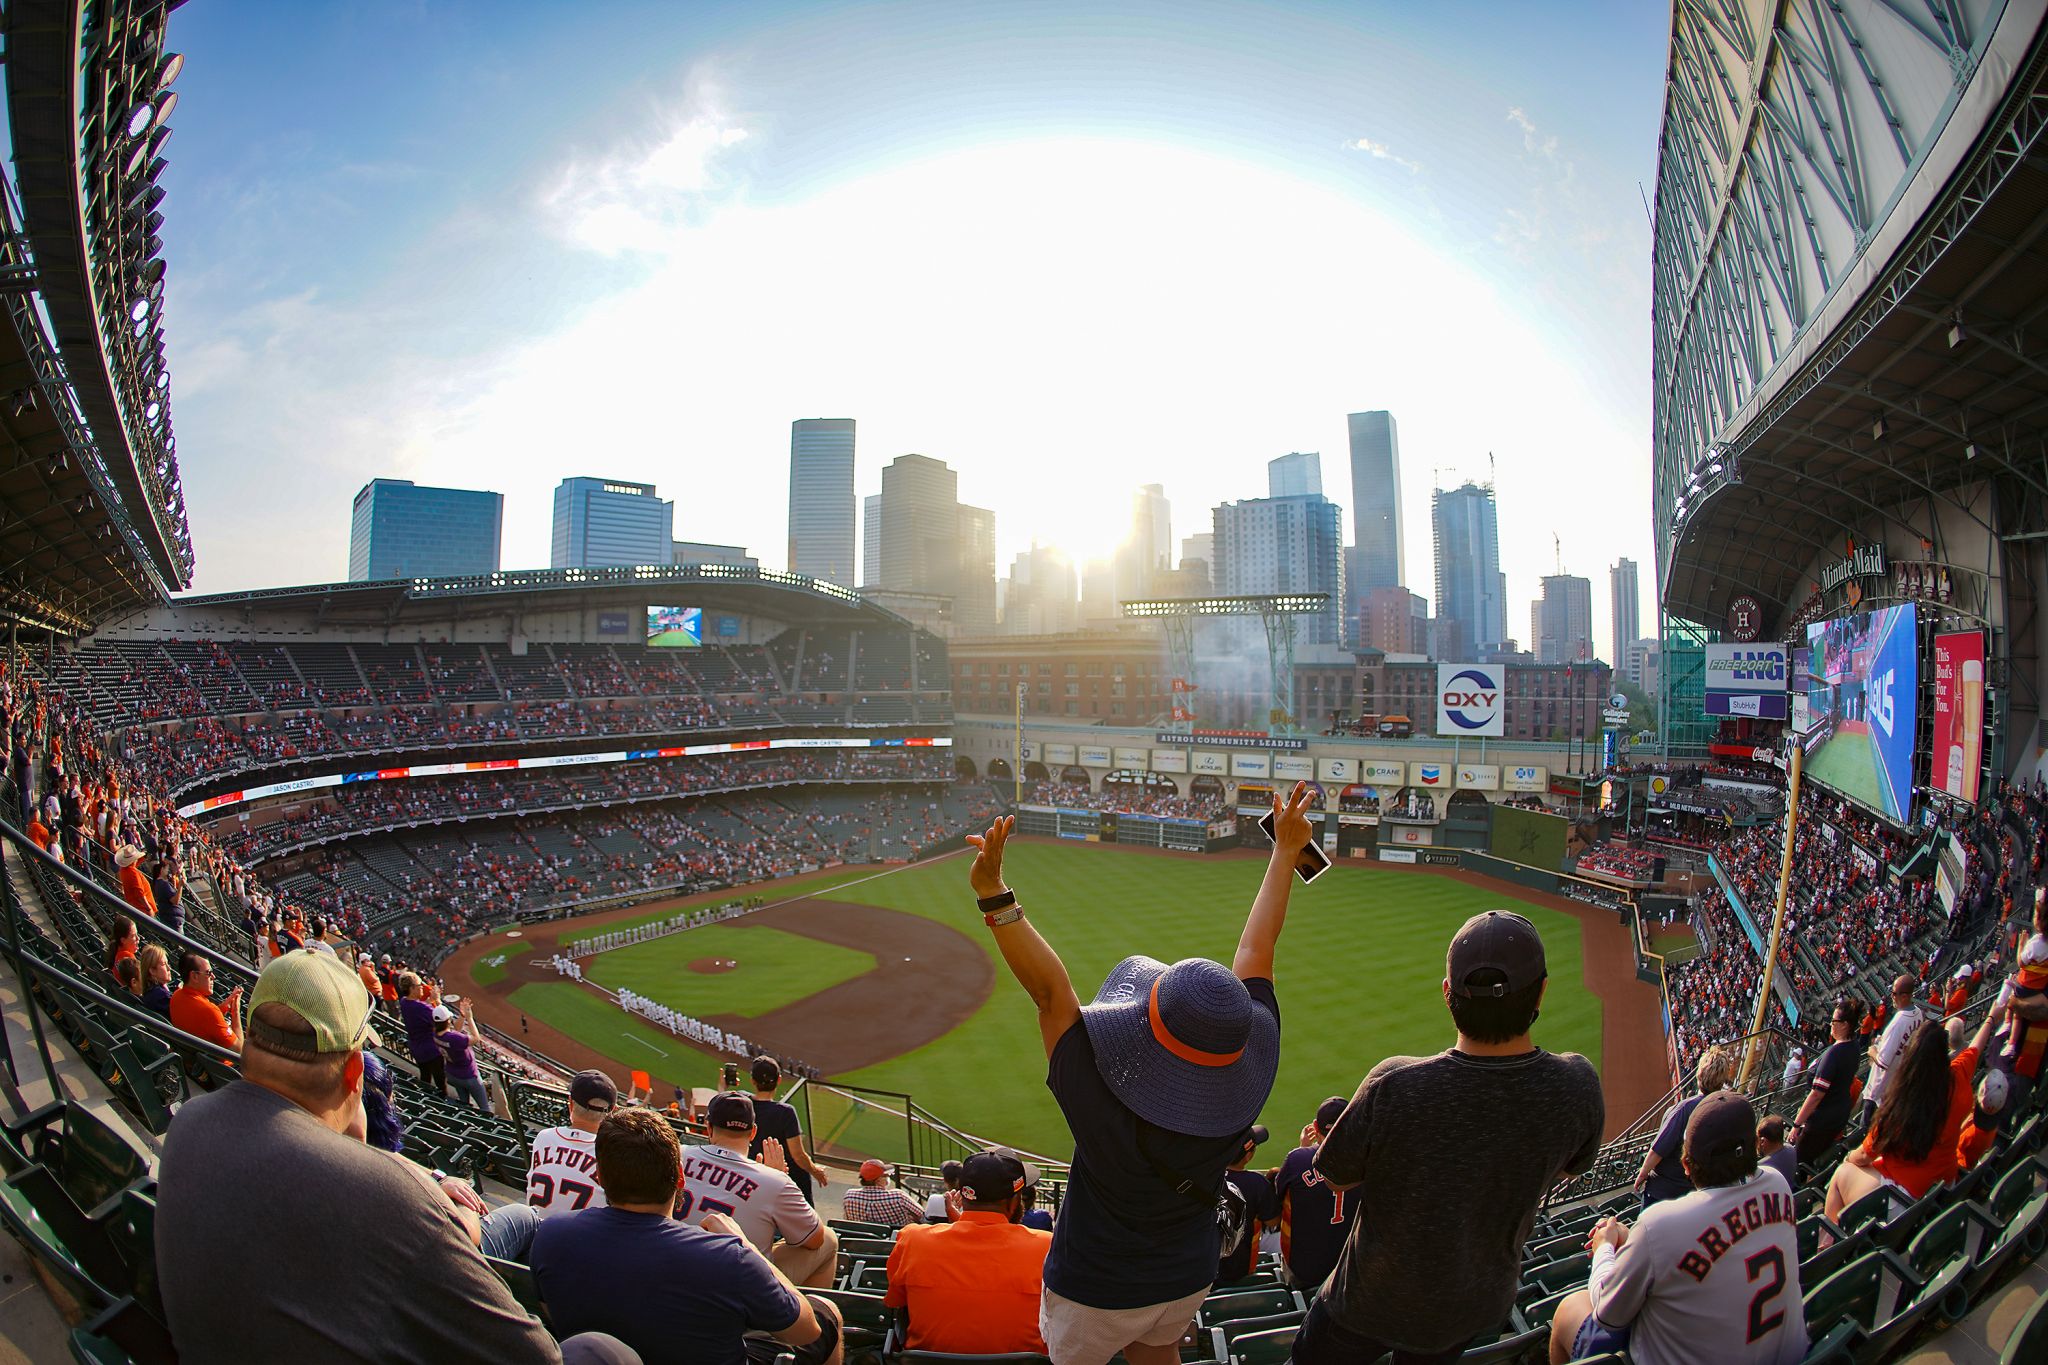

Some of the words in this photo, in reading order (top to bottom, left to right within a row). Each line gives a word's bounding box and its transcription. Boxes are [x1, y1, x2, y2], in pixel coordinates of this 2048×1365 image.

[1822, 558, 1854, 590] Minute
[1853, 544, 1884, 574] Maid
[1731, 597, 1757, 613] HOUSTON
[1737, 611, 1750, 629] H
[1733, 627, 1757, 641] ASTROS
[1936, 647, 1950, 662] This
[1708, 659, 1775, 671] FREEPORT
[1733, 651, 1785, 681] LNG
[1936, 664, 1952, 679] Bud's
[1936, 681, 1947, 696] For
[1443, 692, 1498, 707] OXY
[1732, 701, 1757, 711] StubHub
[1936, 698, 1949, 713] You.
[1602, 708, 1631, 718] Gallagher
[1161, 734, 1194, 744] ASTROS
[1197, 737, 1255, 747] COMMUNITY
[1259, 739, 1302, 749] LEADERS
[1376, 767, 1400, 777] CRANE
[273, 784, 291, 793] JASON
[292, 779, 315, 790] CASTRO
[1669, 802, 1681, 811] MLB
[1680, 804, 1706, 815] NETWORK
[1431, 855, 1457, 863] VERITEX
[684, 1157, 760, 1201] LTUVE
[529, 1173, 595, 1210] 27
[1676, 1192, 1797, 1283] BREGMA
[1744, 1244, 1786, 1345] 2
